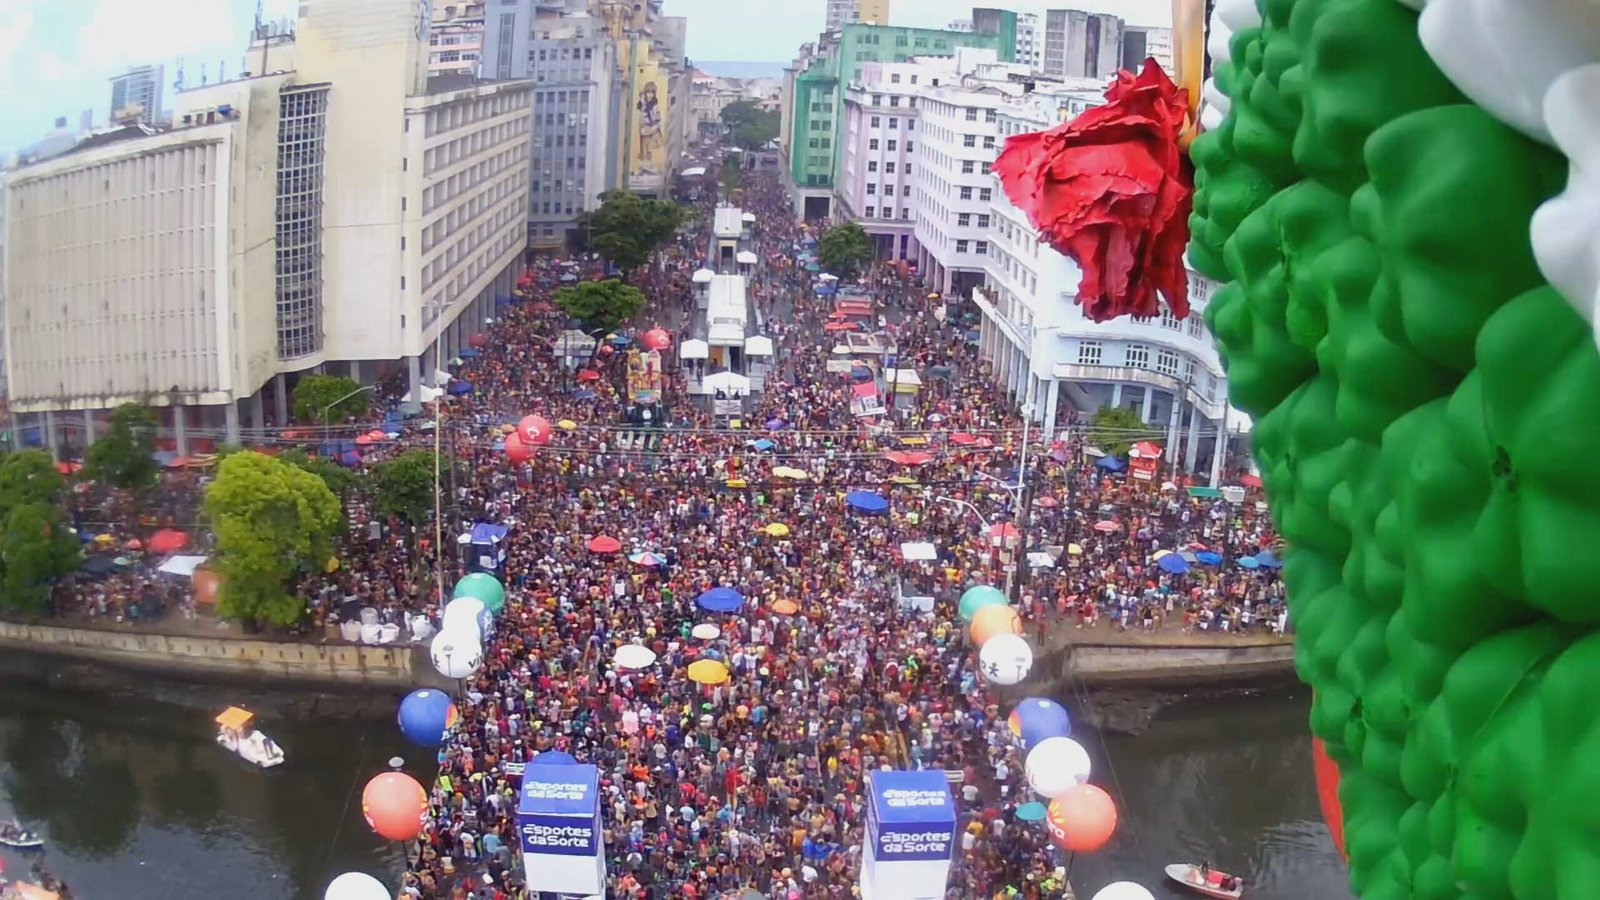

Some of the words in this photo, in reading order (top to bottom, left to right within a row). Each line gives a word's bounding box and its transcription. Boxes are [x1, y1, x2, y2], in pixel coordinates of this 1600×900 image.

[525, 781, 587, 792] Esportes
[883, 789, 946, 799] Esportes
[523, 824, 592, 837] Esportes
[880, 832, 951, 844] Esportes
